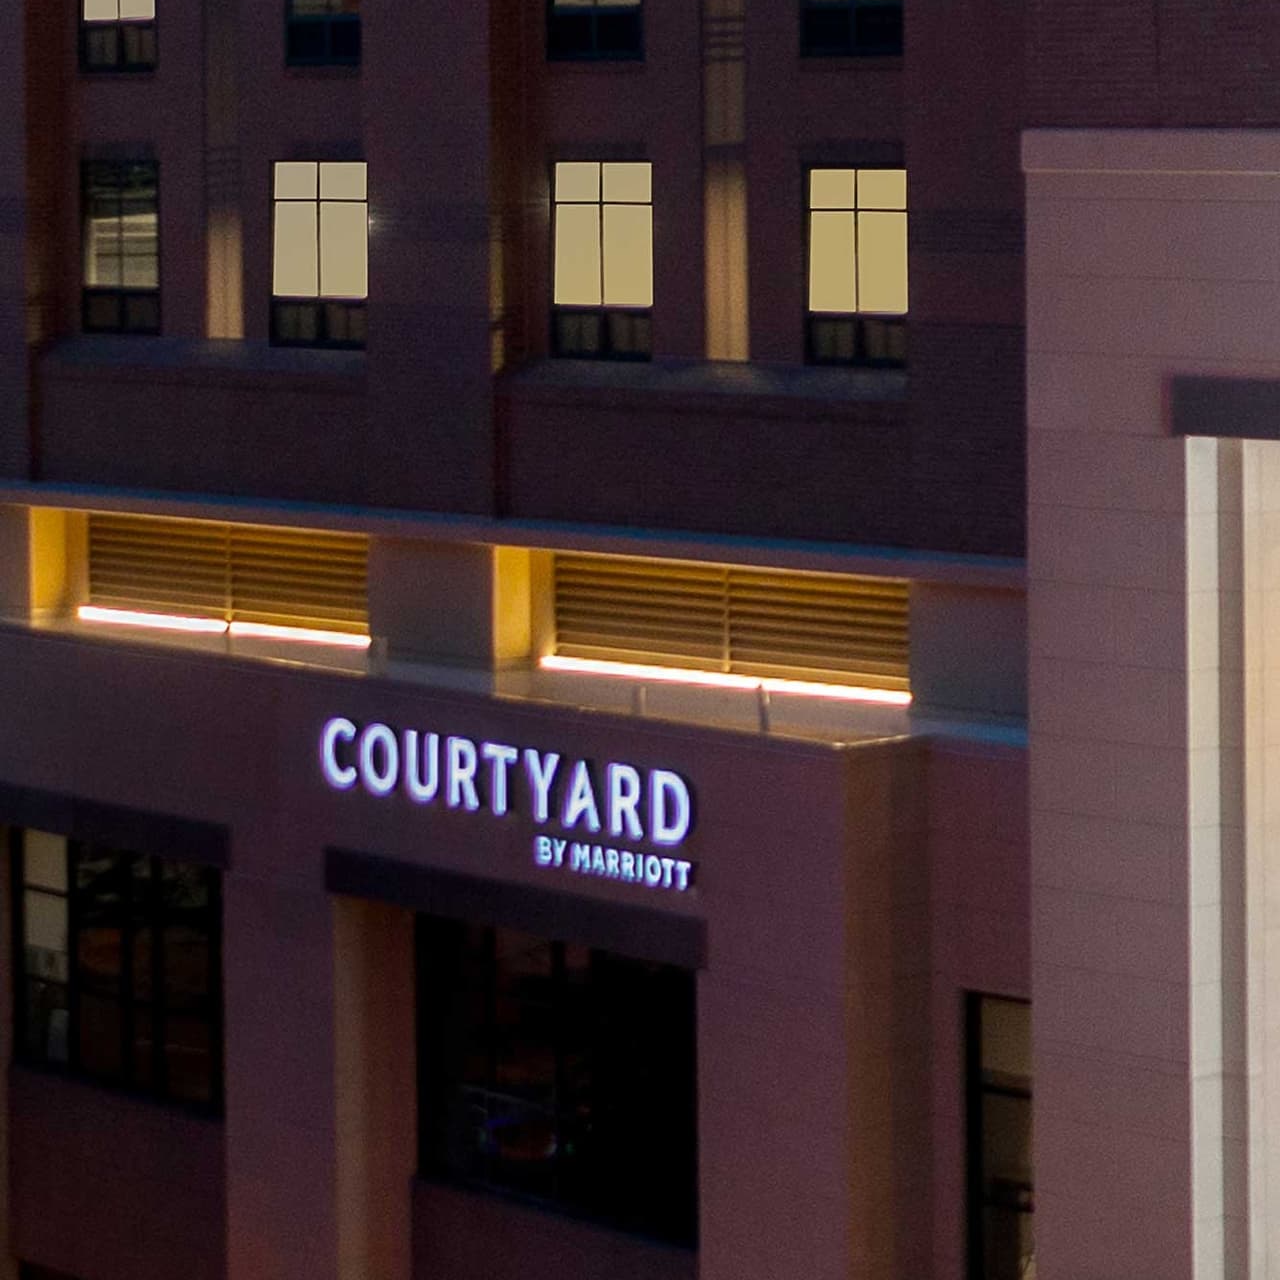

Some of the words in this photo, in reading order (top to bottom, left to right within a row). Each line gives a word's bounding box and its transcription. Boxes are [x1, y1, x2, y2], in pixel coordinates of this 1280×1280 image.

[320, 715, 692, 847] COURTYARD
[534, 834, 568, 868] BY
[569, 841, 692, 891] MARRIOTT
